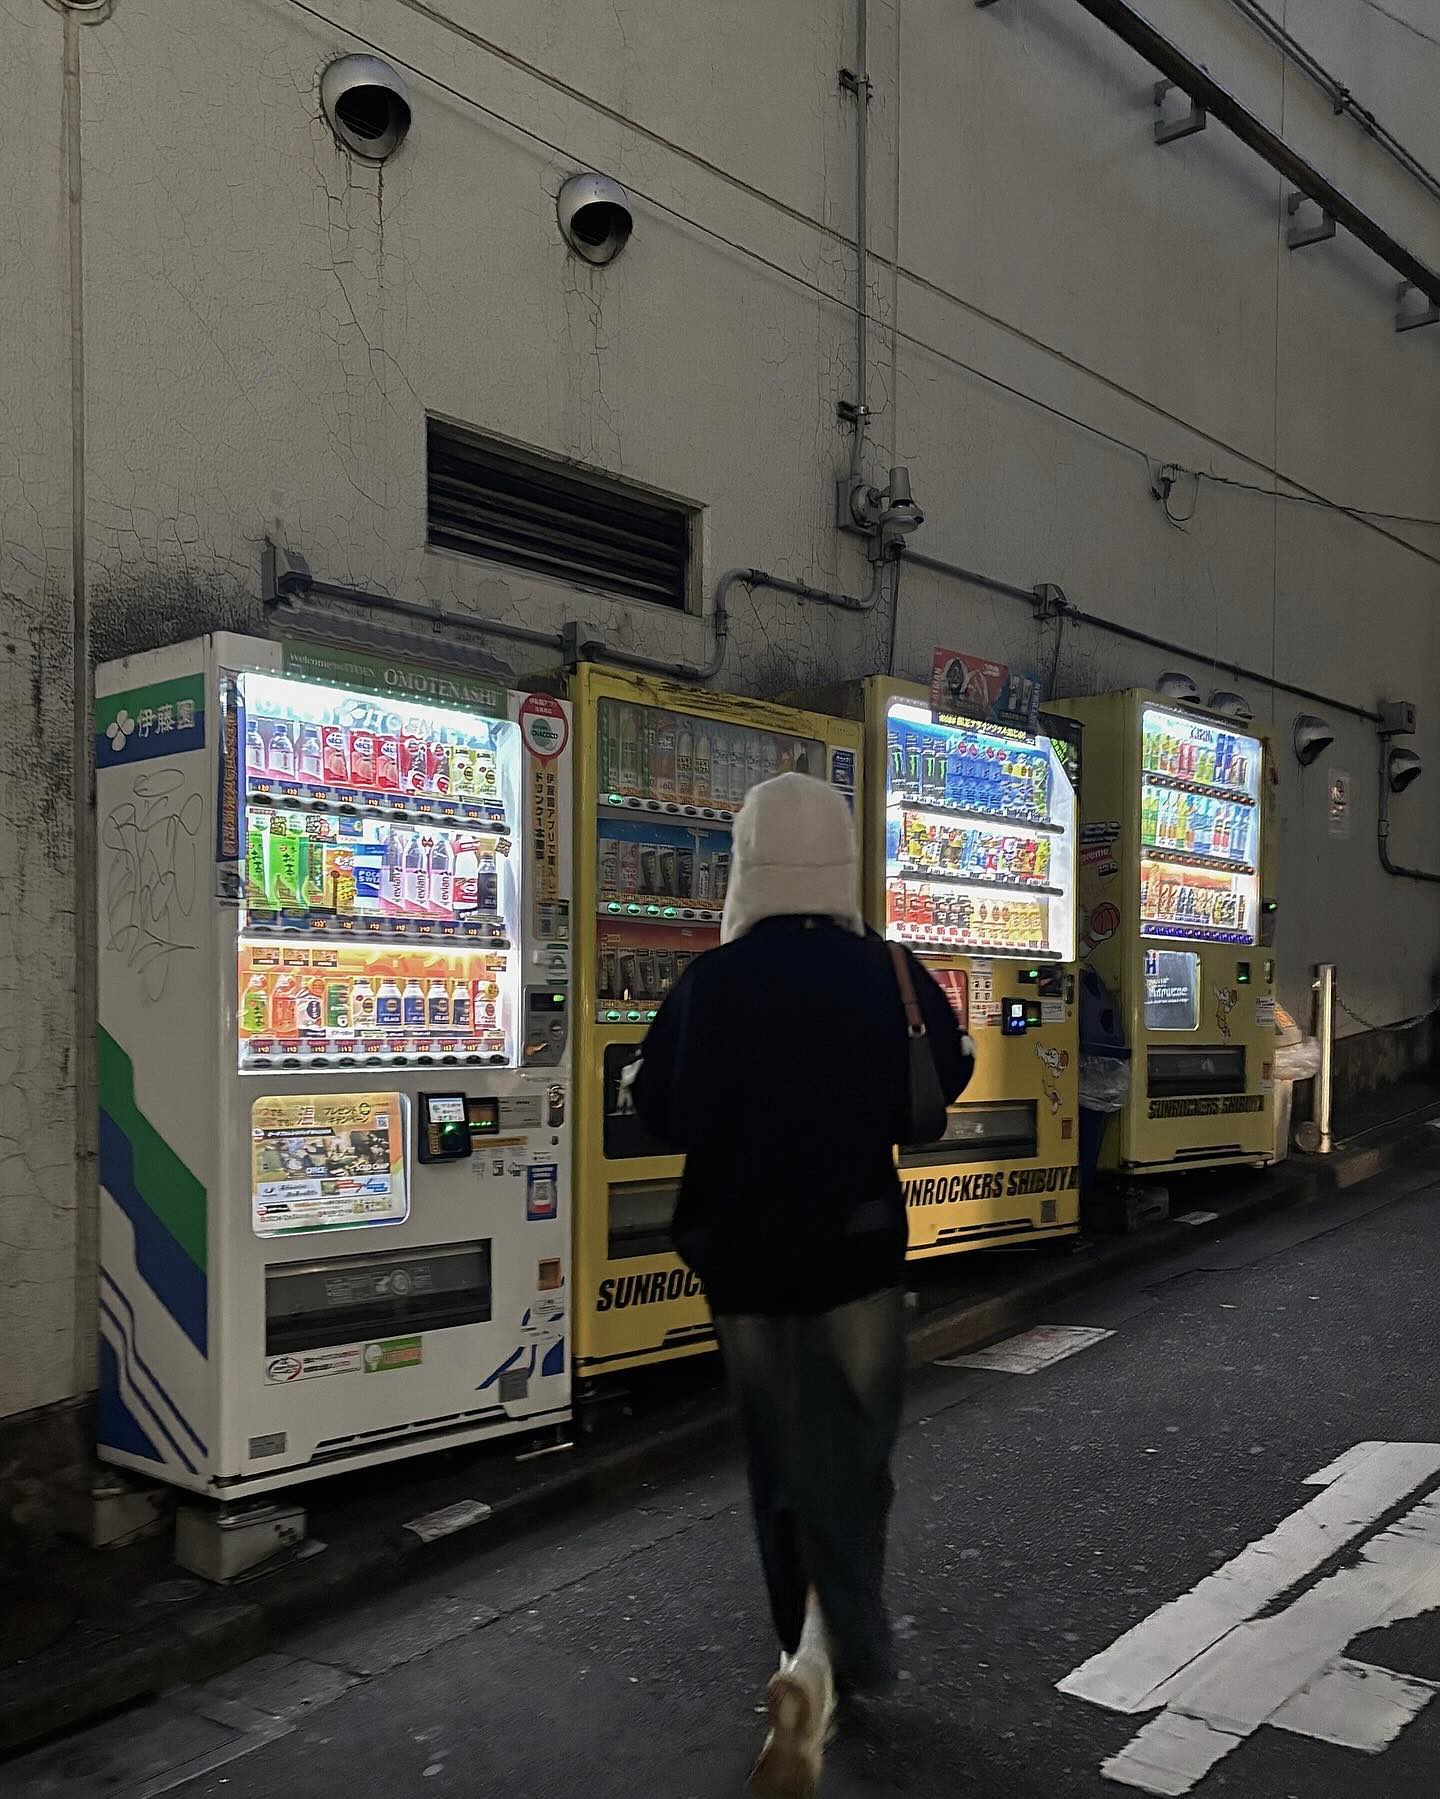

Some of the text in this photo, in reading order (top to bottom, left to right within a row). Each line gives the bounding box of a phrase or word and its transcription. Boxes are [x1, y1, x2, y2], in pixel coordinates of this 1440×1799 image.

[384, 668, 497, 706] OMOTENASHI
[137, 699, 195, 737] 伊藤園
[417, 874, 425, 899] evian
[442, 876, 450, 901] evian
[596, 1268, 705, 1311] SUNROC
